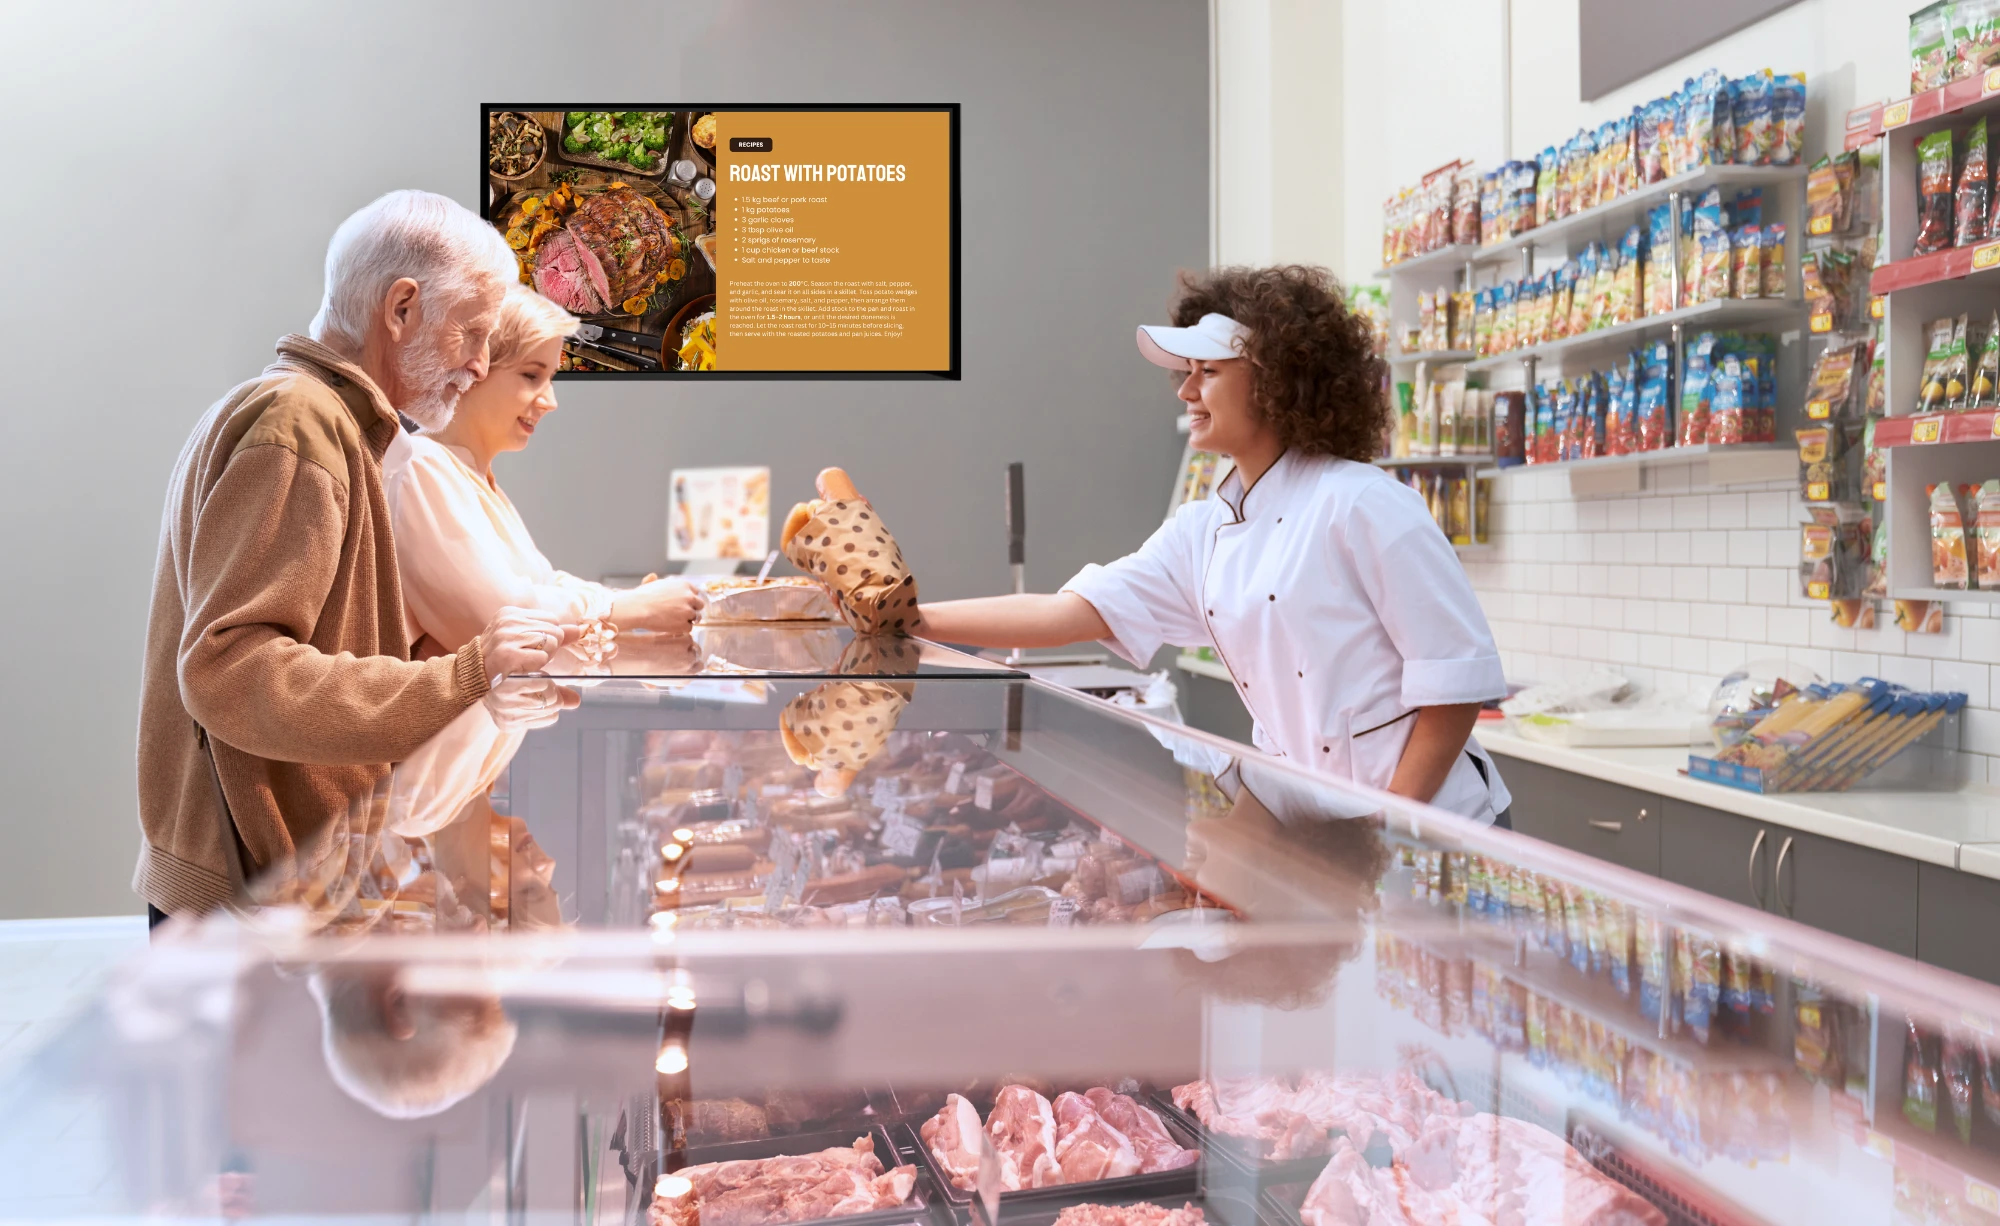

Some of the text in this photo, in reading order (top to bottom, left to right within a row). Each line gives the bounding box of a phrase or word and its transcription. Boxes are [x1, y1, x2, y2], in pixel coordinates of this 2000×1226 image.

[729, 164, 906, 182] ROAST WITH POTATOES
[751, 196, 762, 205] kg
[762, 195, 780, 203] beef
[790, 196, 807, 205] pork
[745, 206, 756, 215] kg
[756, 206, 790, 215] potatoes
[741, 216, 795, 226] 3 garlic cloves
[741, 226, 794, 236] 3 tbsp olive oil
[741, 236, 817, 246] 2 sprigs of rosemary
[745, 247, 761, 256] cup
[761, 246, 791, 254] chicken
[801, 246, 819, 254] beef
[819, 246, 840, 254] stock
[741, 256, 756, 264] Salt
[757, 256, 773, 264] and
[773, 257, 801, 266] pepper
[894, 288, 918, 297] wedges
[884, 330, 903, 338] Enjoy!
